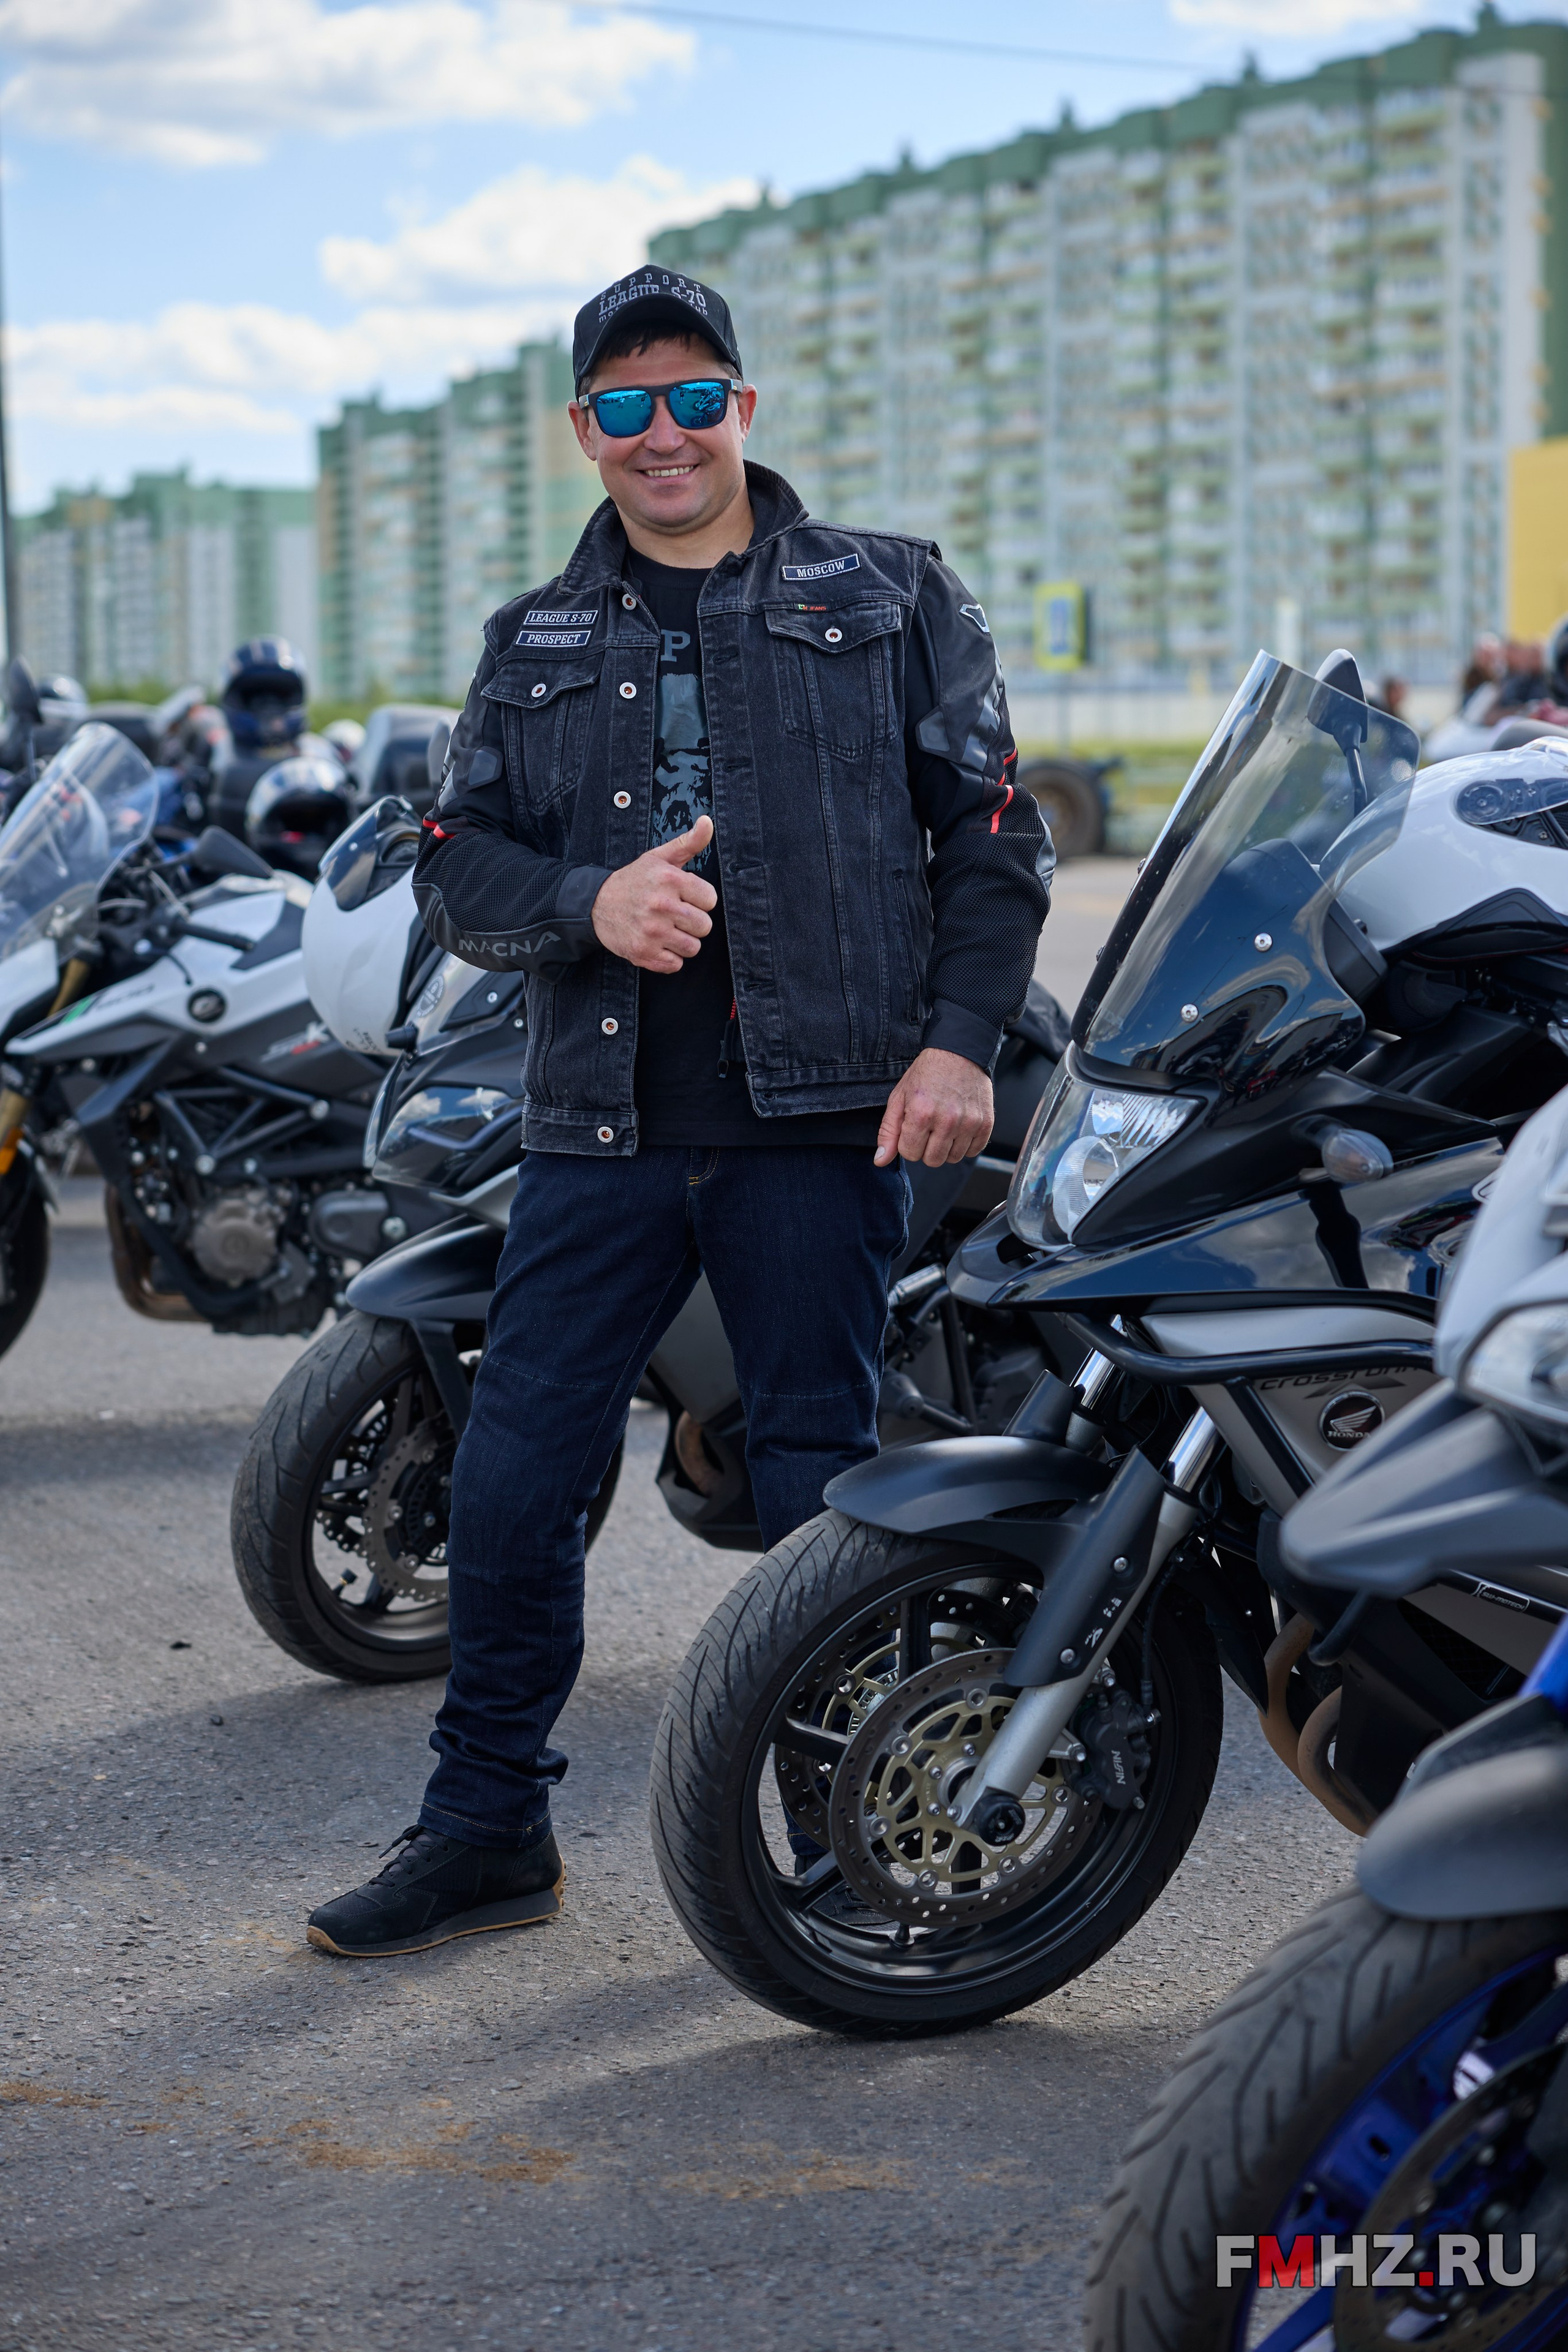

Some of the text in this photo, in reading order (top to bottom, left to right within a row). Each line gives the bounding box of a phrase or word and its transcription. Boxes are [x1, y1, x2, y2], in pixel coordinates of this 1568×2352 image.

[601, 273, 701, 300] SUPPORT
[598, 284, 660, 315] LEAGUE
[671, 286, 706, 307] S-70
[796, 560, 845, 578] MOSCOW
[529, 613, 592, 622] LEAGUE S-70
[527, 634, 581, 644] PROSPECT
[459, 931, 561, 957] MACNA
